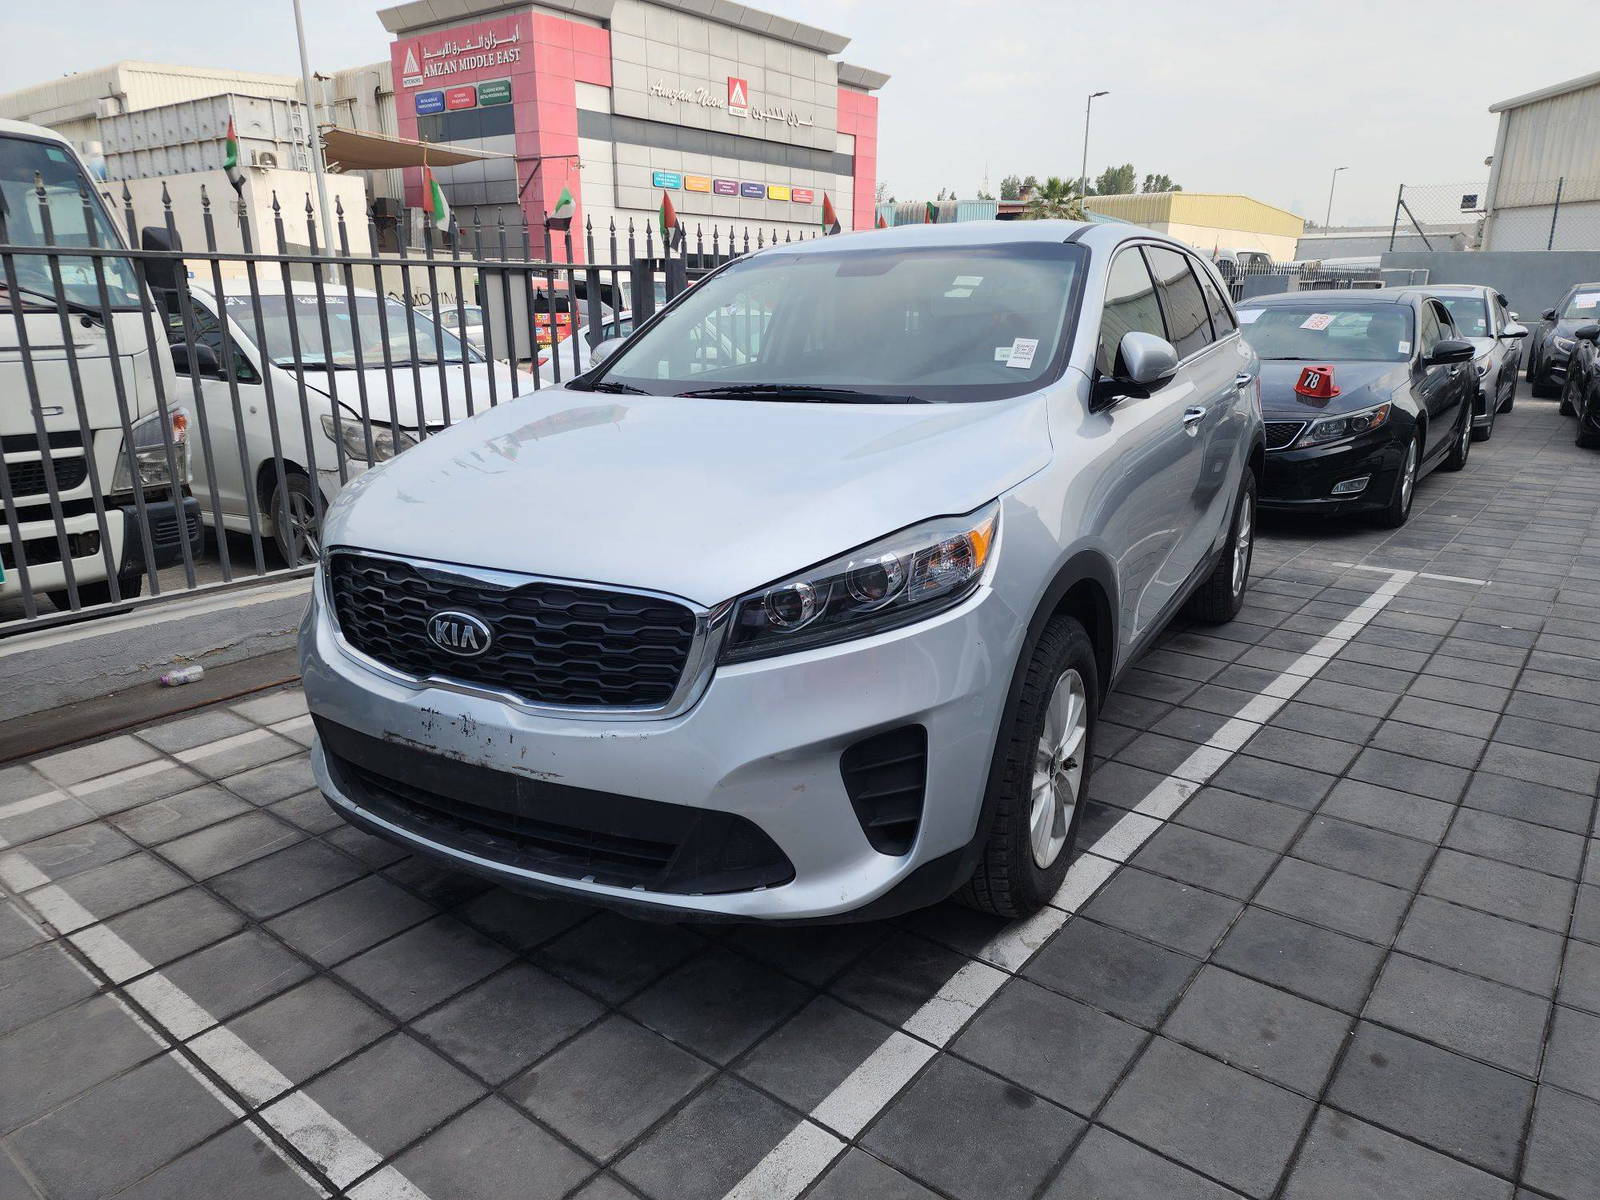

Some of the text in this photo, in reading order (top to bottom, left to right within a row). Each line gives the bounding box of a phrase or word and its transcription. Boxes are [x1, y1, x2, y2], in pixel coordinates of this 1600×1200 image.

[424, 48, 520, 78] AMZAN MIDDLE EAST
[650, 79, 725, 109] Amzan Neon
[1304, 372, 1319, 388] 78
[435, 619, 480, 650] KIA
